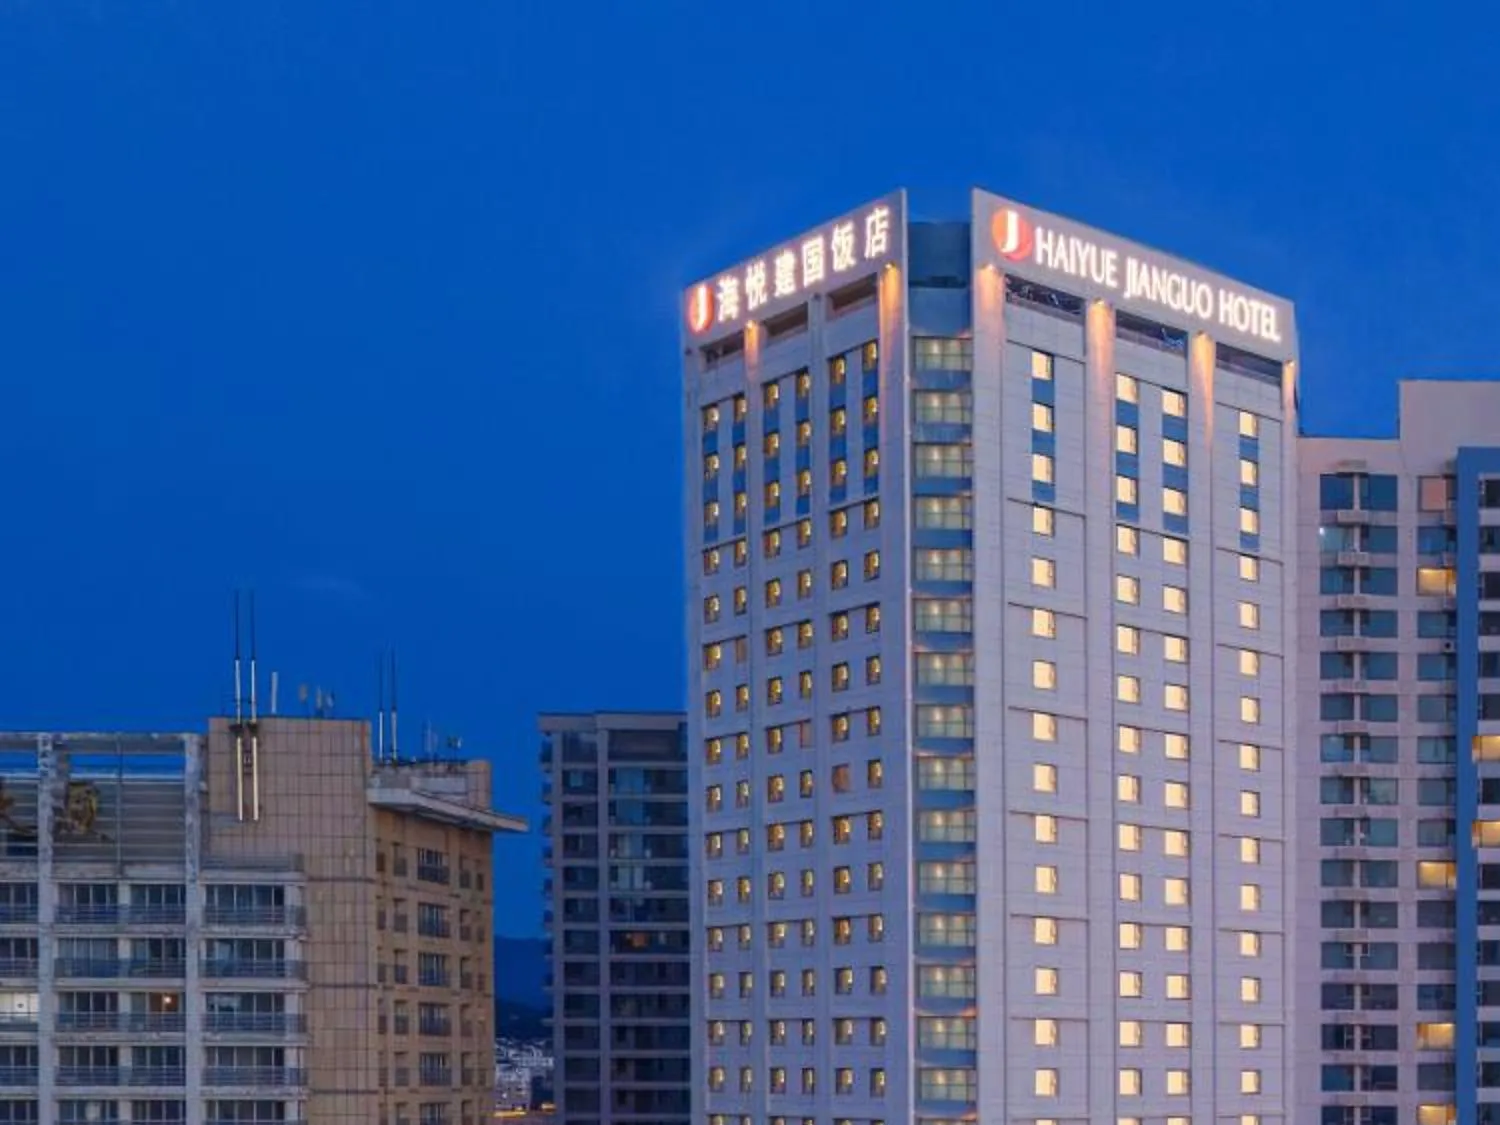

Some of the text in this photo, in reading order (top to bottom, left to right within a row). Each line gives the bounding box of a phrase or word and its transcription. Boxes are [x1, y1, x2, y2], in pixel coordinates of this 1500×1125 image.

[1034, 226, 1281, 342] HAIYUE JIANGUO HOTEL
